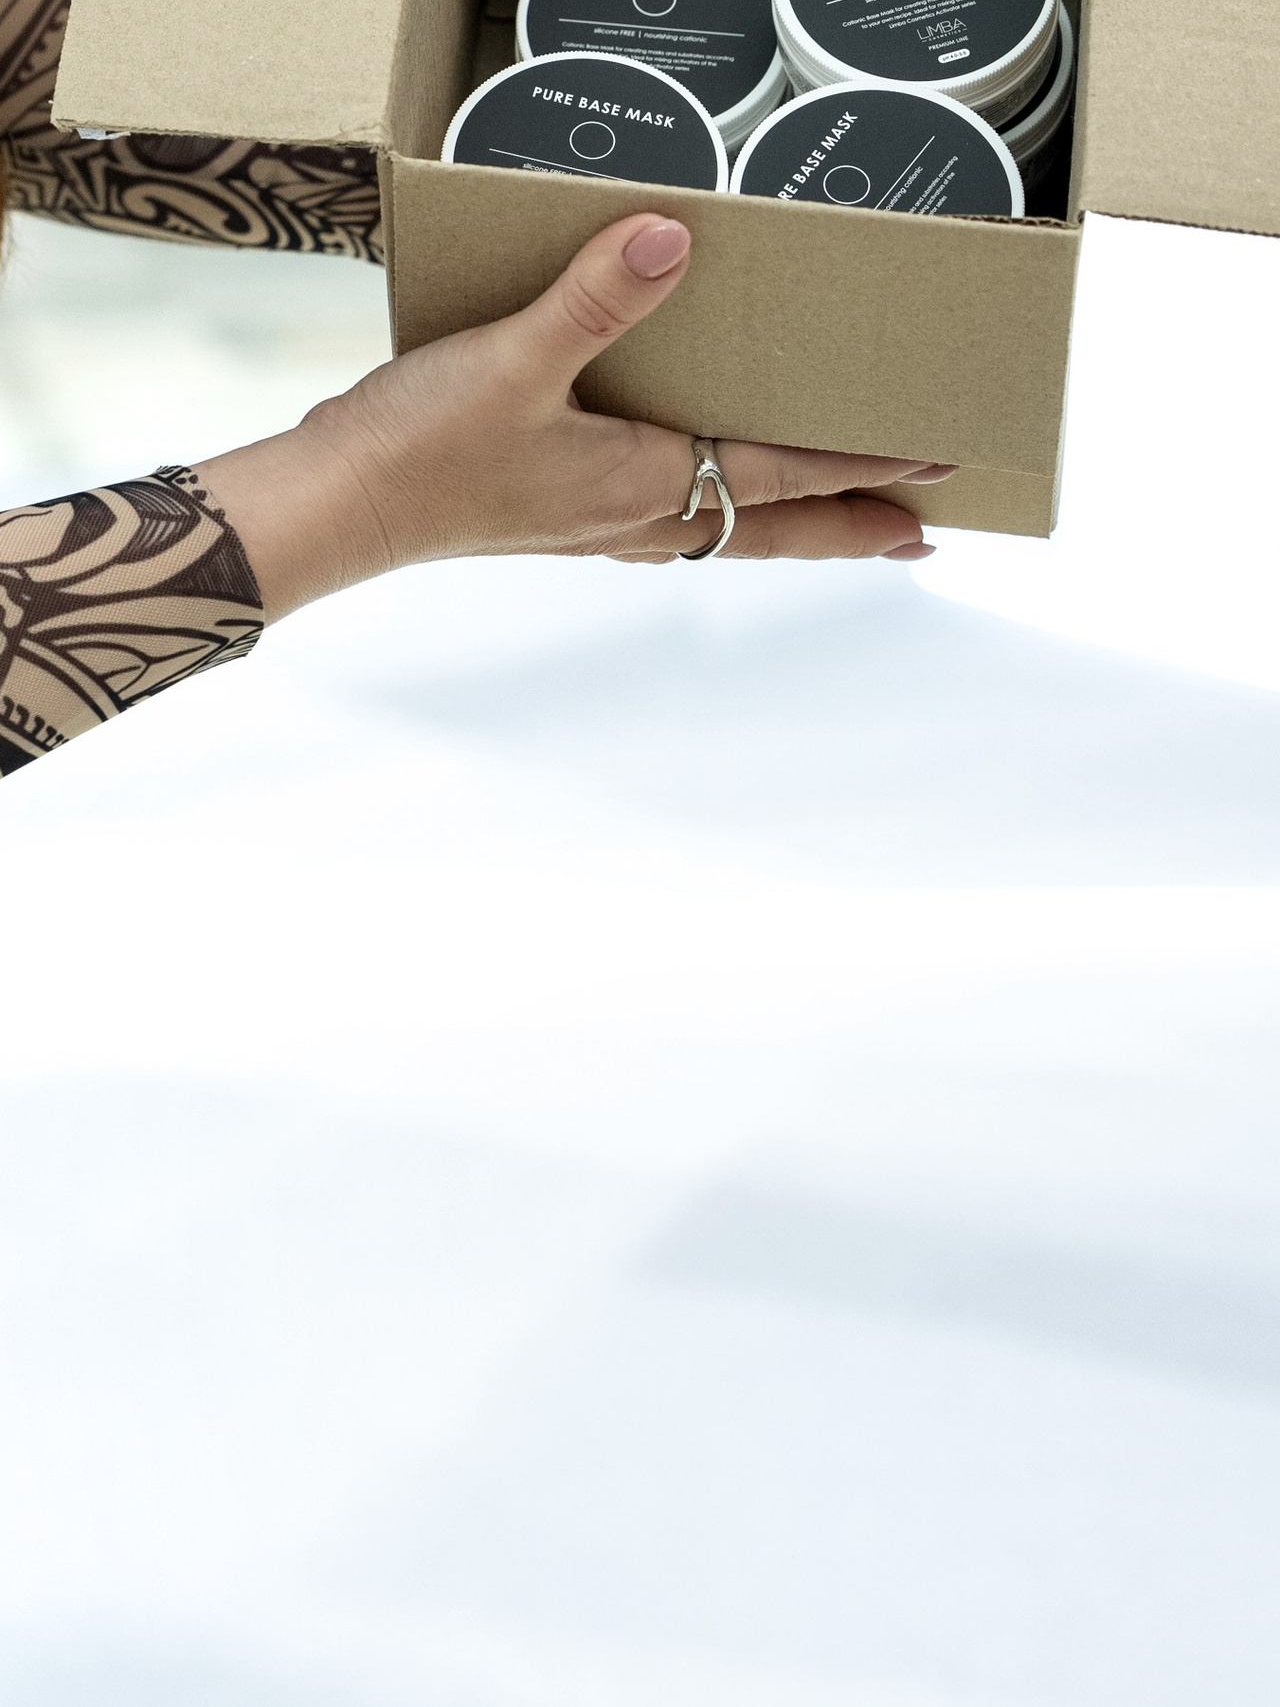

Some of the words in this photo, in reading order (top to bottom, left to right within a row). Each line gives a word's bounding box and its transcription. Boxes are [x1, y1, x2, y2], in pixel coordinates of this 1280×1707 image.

[916, 17, 966, 39] LIMBA
[532, 86, 573, 105] PURE
[578, 96, 621, 116] BASE
[624, 107, 675, 128] MASK
[792, 149, 826, 184] BASE
[820, 111, 858, 151] MASK
